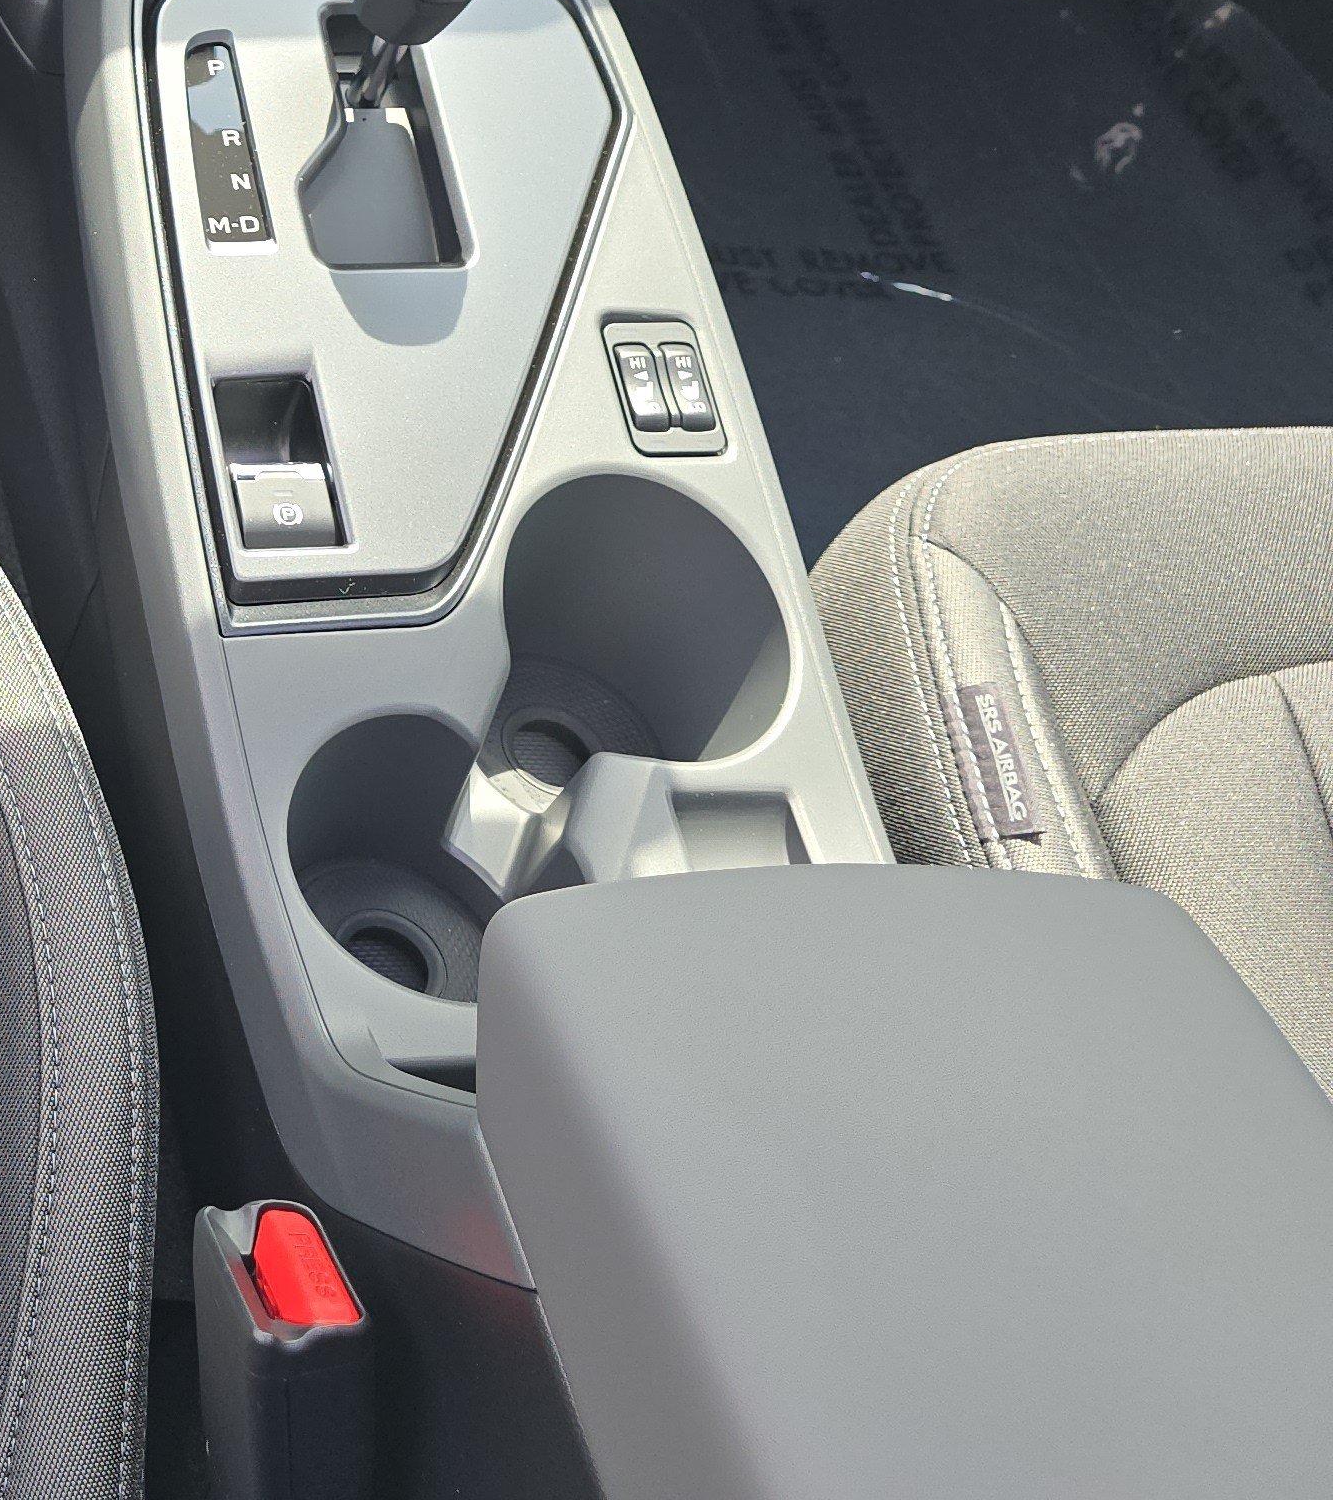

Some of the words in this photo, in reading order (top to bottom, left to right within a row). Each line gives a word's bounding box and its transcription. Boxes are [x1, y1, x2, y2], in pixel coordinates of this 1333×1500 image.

[207, 59, 225, 76] P
[221, 129, 242, 147] R
[230, 173, 252, 190] N
[207, 215, 260, 234] M-D
[628, 356, 647, 370] HI
[675, 356, 692, 370] HI
[978, 692, 1003, 735] SRS
[991, 738, 1029, 822] AIRBAG
